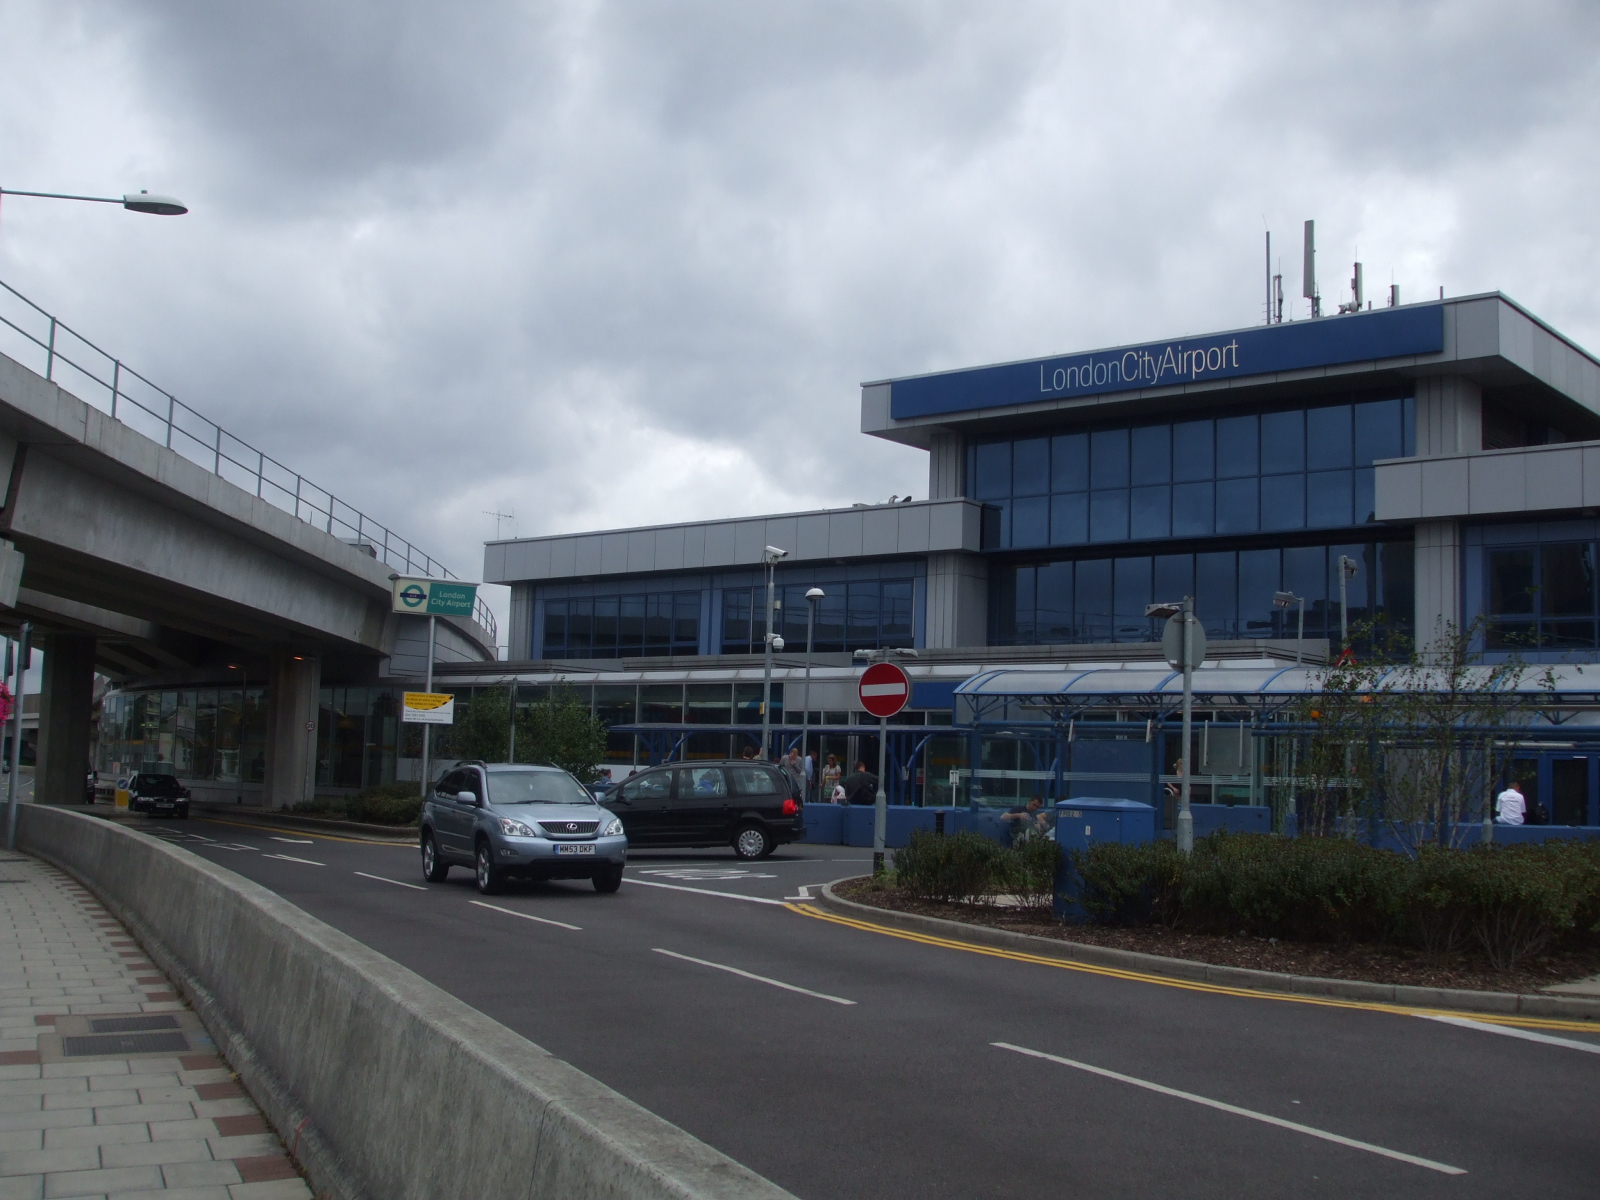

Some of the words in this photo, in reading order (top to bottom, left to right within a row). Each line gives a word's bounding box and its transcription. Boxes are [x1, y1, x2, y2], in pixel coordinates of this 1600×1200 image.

[439, 590, 466, 599] London
[431, 598, 445, 607] City
[446, 599, 471, 608] Airport
[579, 845, 593, 853] DKF
